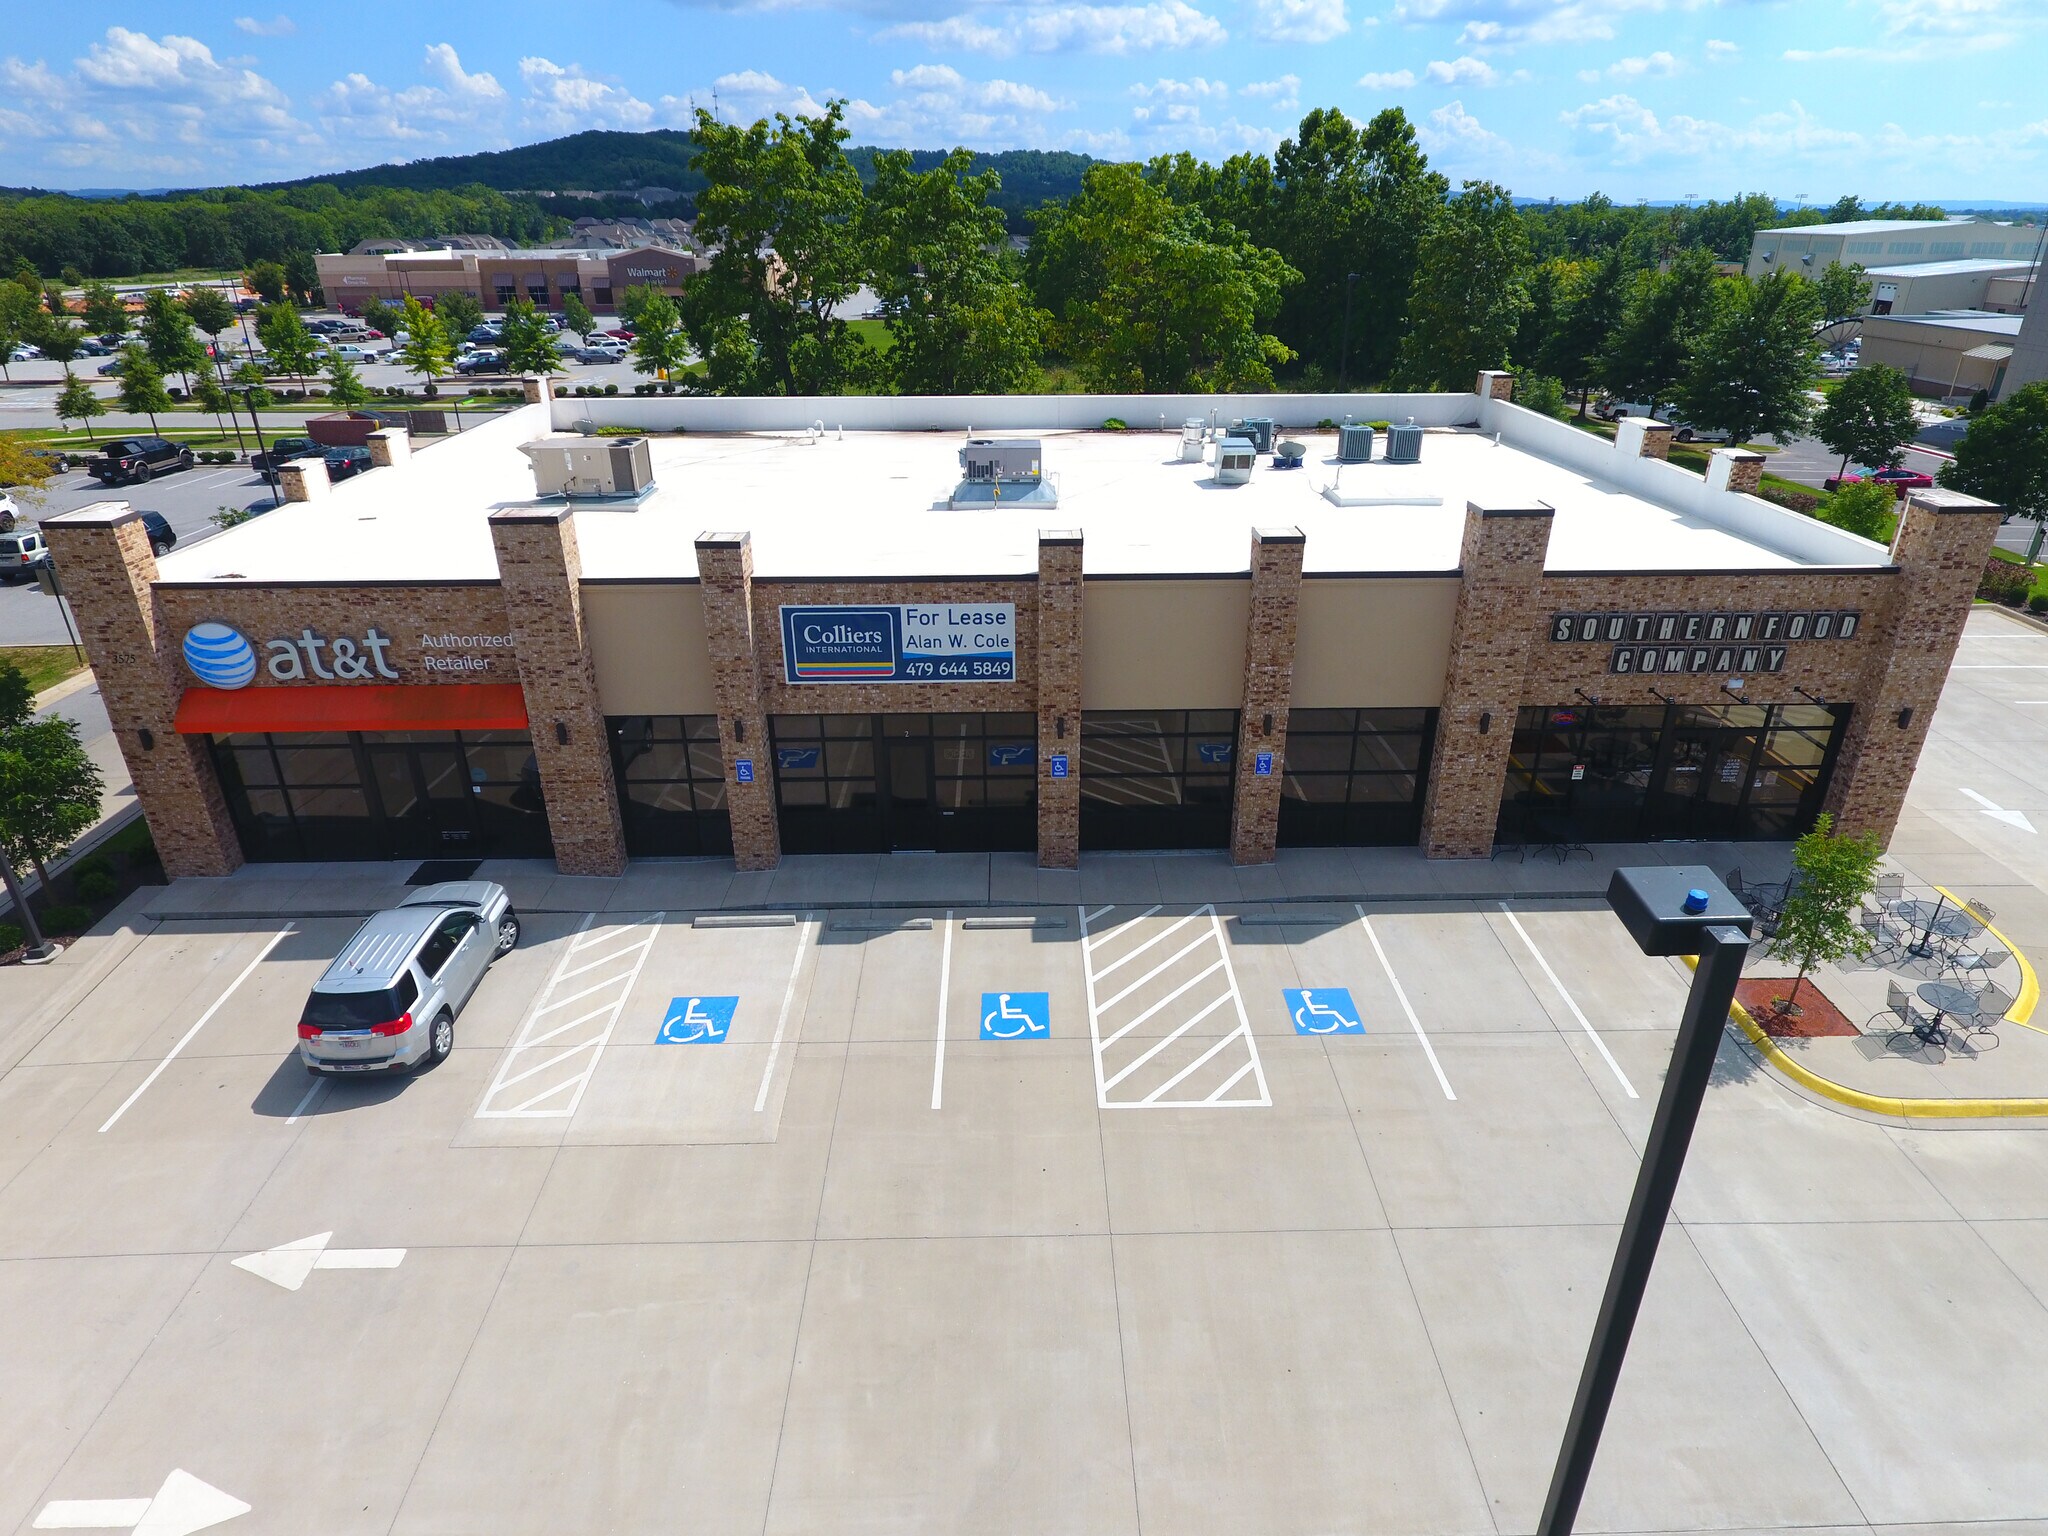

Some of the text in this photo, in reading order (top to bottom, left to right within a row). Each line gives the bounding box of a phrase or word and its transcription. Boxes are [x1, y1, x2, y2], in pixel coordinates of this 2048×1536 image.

[627, 267, 667, 277] Walmart
[906, 608, 1007, 626] For Lease
[421, 632, 514, 648] Authorized
[803, 625, 882, 644] Colliers
[906, 634, 1010, 649] Alan W. Cole
[265, 628, 399, 680] at&t
[1616, 649, 1786, 673] COMPANY
[424, 655, 490, 671] Retailer
[906, 662, 1010, 676] 479 644 5849
